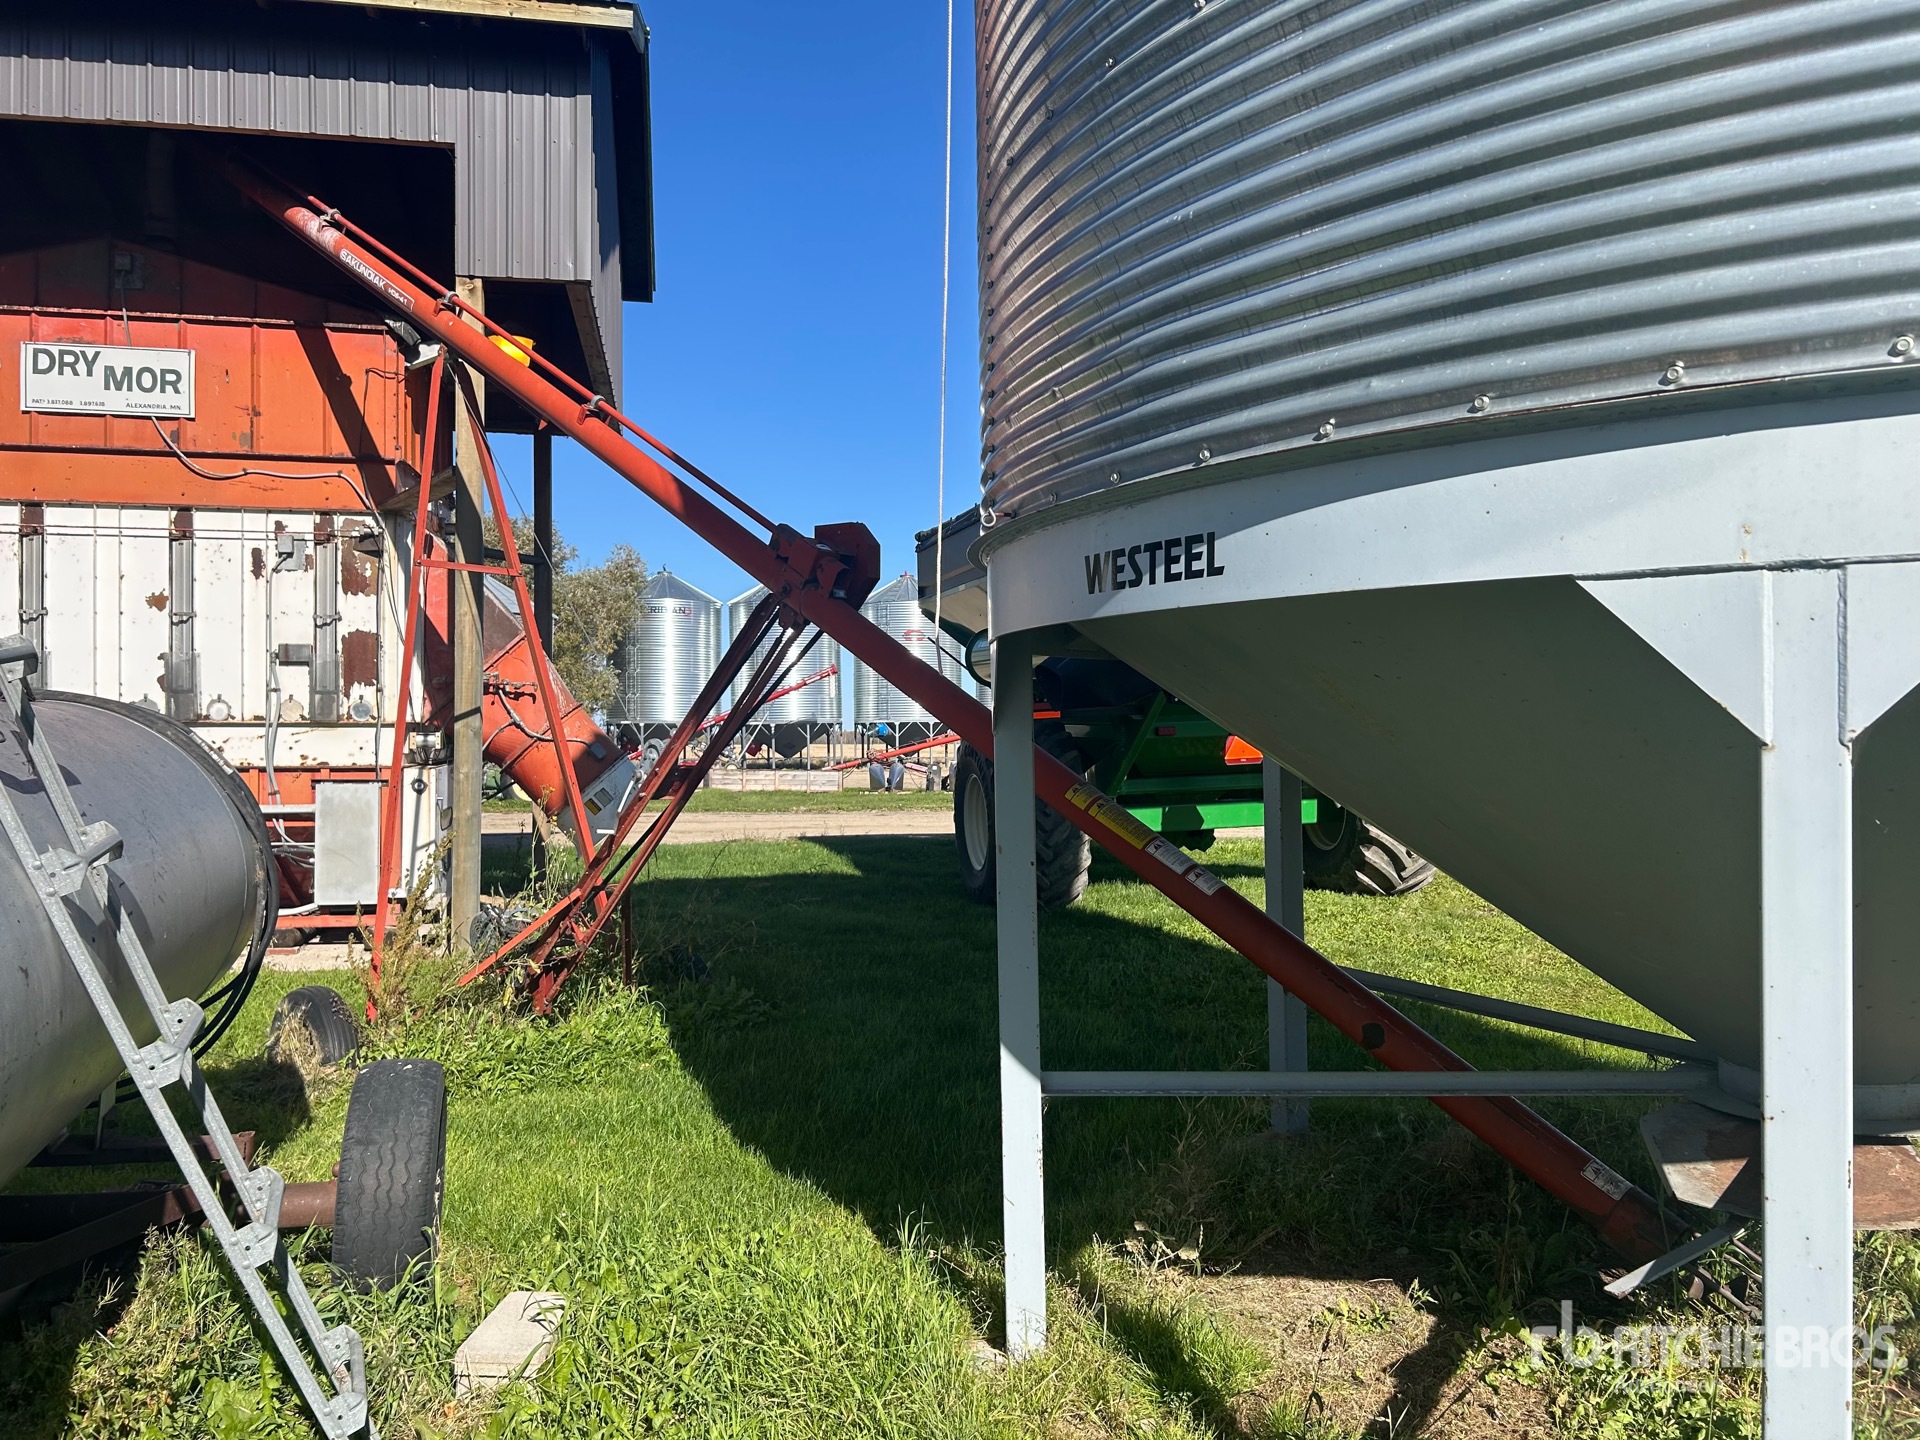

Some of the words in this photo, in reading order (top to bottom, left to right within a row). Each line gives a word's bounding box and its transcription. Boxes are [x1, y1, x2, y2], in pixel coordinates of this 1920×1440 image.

[340, 250, 387, 291] SAKUNDIAK
[31, 347, 102, 377] DRY
[103, 365, 183, 395] MOR
[1084, 531, 1226, 595] WESTEEL
